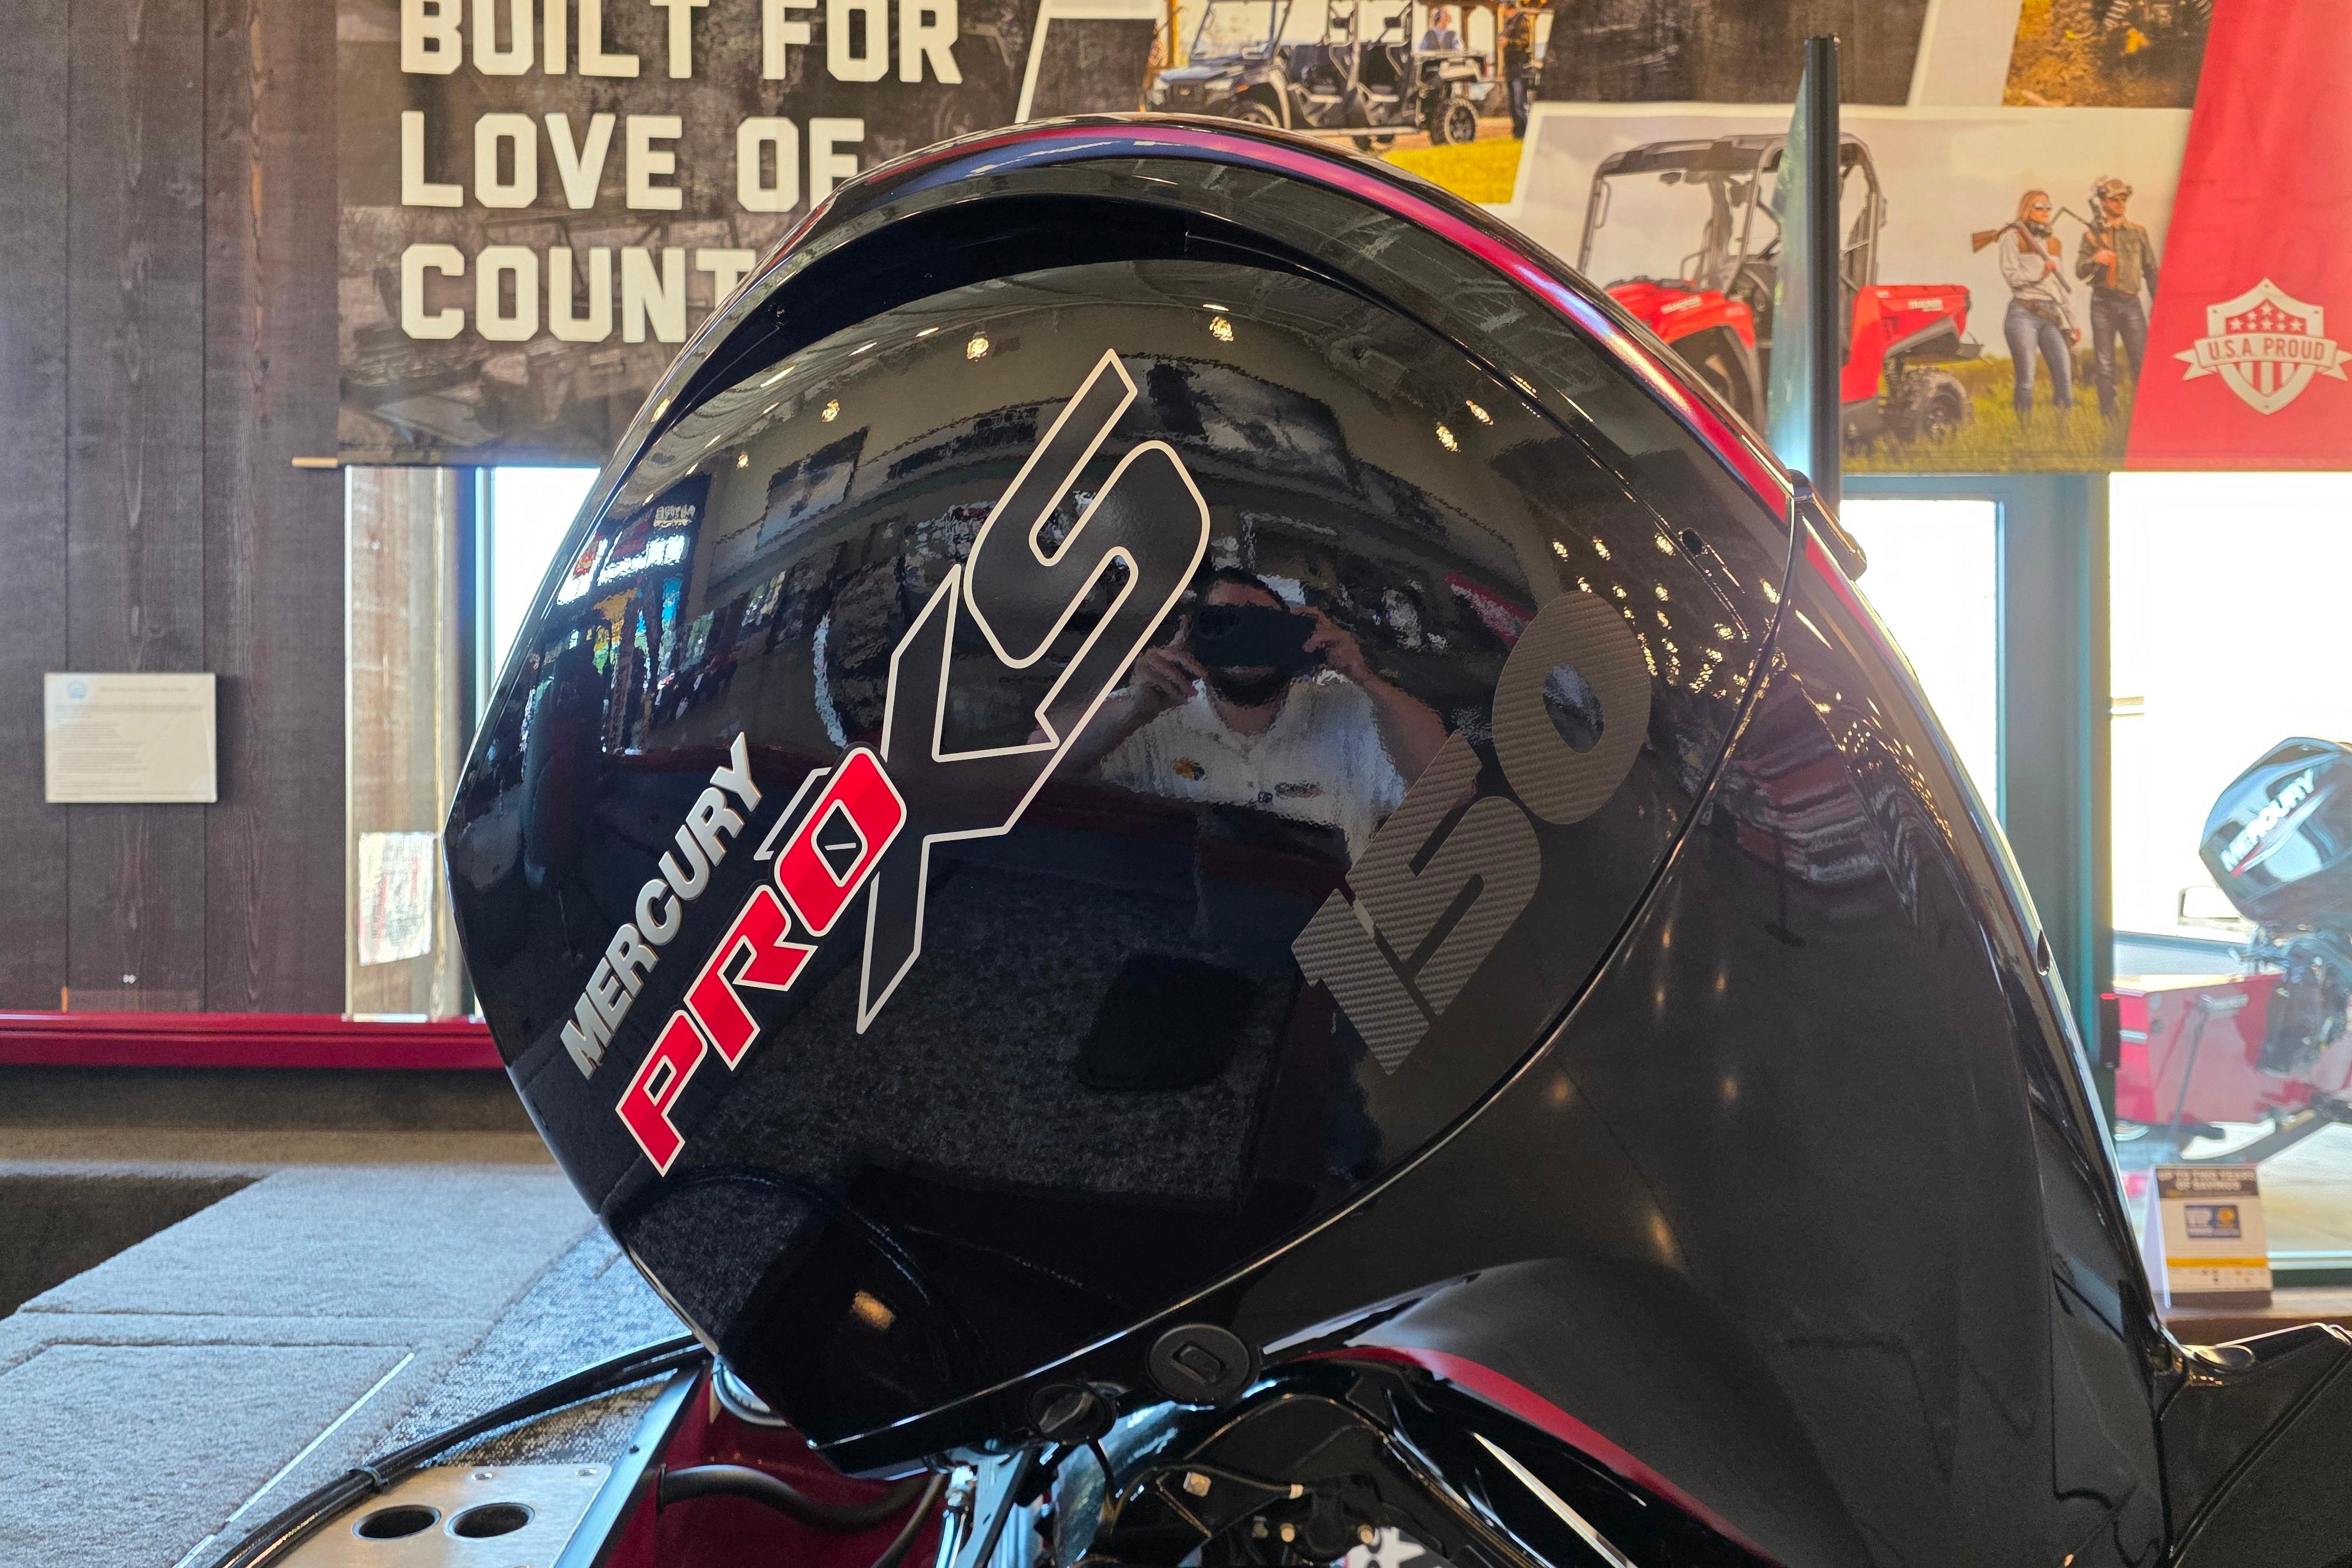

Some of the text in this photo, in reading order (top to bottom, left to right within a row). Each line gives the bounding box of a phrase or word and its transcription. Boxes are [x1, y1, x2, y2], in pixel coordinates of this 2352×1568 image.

[400, 0, 963, 85] BUILT FOR
[400, 110, 865, 212] LOVE OF
[2264, 337, 2325, 360] PROUD
[560, 731, 763, 1080] MERCURY
[1291, 589, 1651, 1076] 150
[615, 747, 907, 1178] PRO
